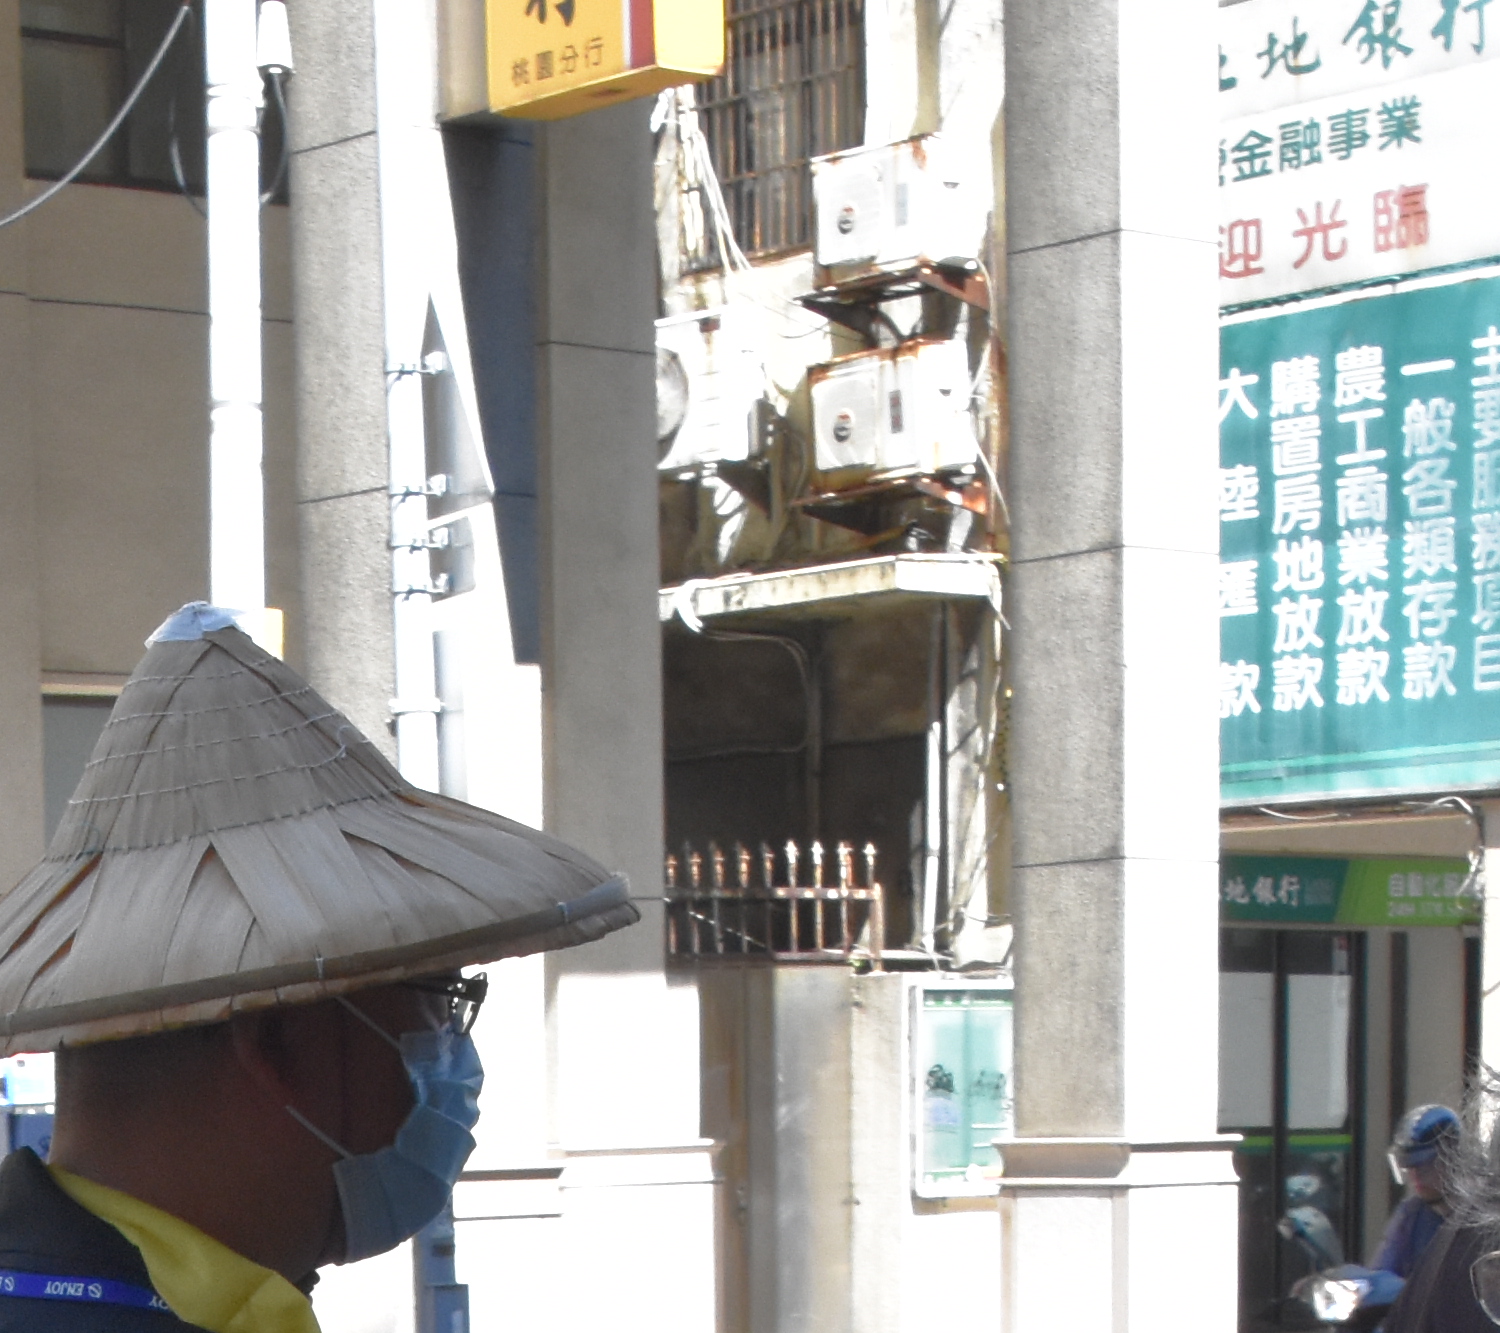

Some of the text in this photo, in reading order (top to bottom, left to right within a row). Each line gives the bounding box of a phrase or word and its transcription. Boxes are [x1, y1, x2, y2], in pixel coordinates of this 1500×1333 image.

[1271, 355, 1325, 712] 購置房地放款
[1335, 345, 1390, 705] 農工商業放款
[1401, 358, 1457, 700] 一般各類存款
[44, 1280, 85, 1297] ENJOY
